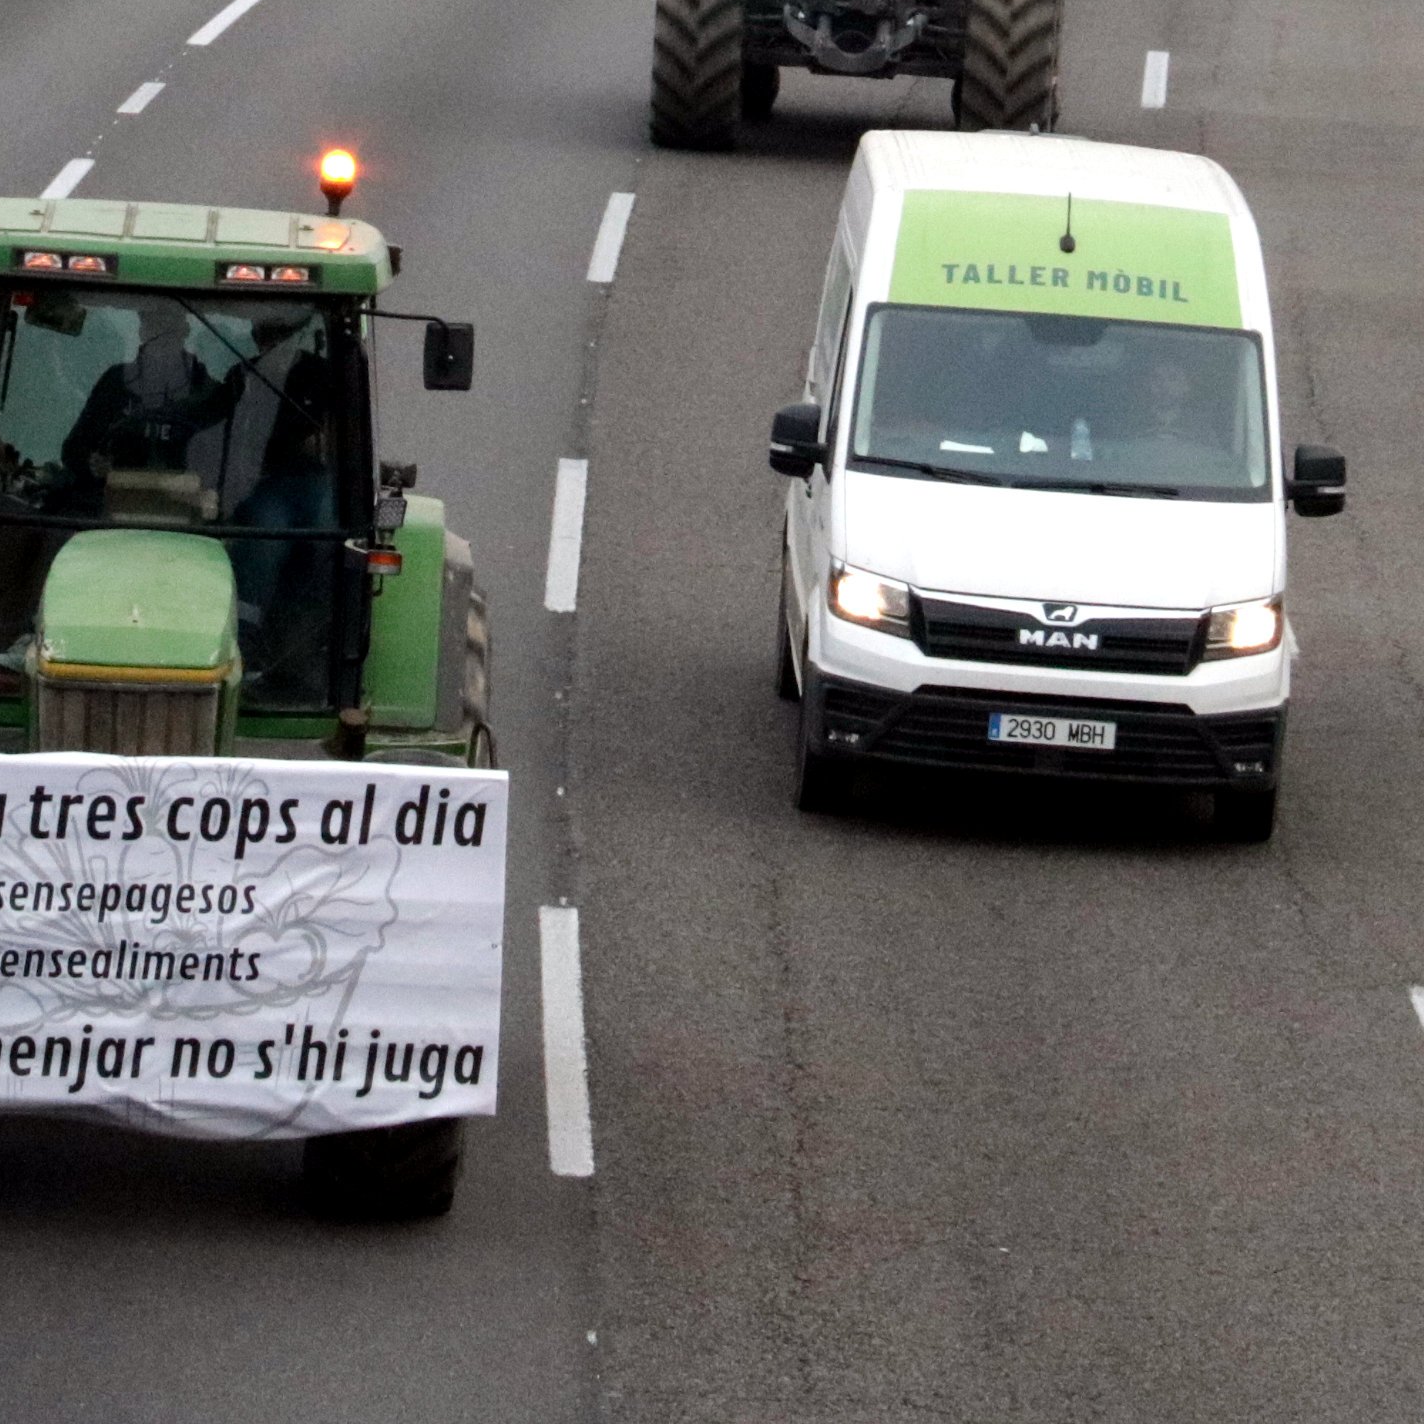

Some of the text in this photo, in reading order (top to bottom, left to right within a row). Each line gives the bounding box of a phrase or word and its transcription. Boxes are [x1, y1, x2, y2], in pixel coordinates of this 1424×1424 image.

[941, 263, 1189, 304] TALLER MÒBIL
[1018, 628, 1099, 651] MAN
[1006, 718, 1107, 746] 2930 MBH
[28, 783, 146, 843] tres
[166, 796, 300, 861] cops
[320, 782, 377, 847] al
[394, 782, 488, 849] dia
[169, 1036, 236, 1079] no
[253, 1022, 350, 1083] s'hi
[354, 1028, 485, 1100] juga
